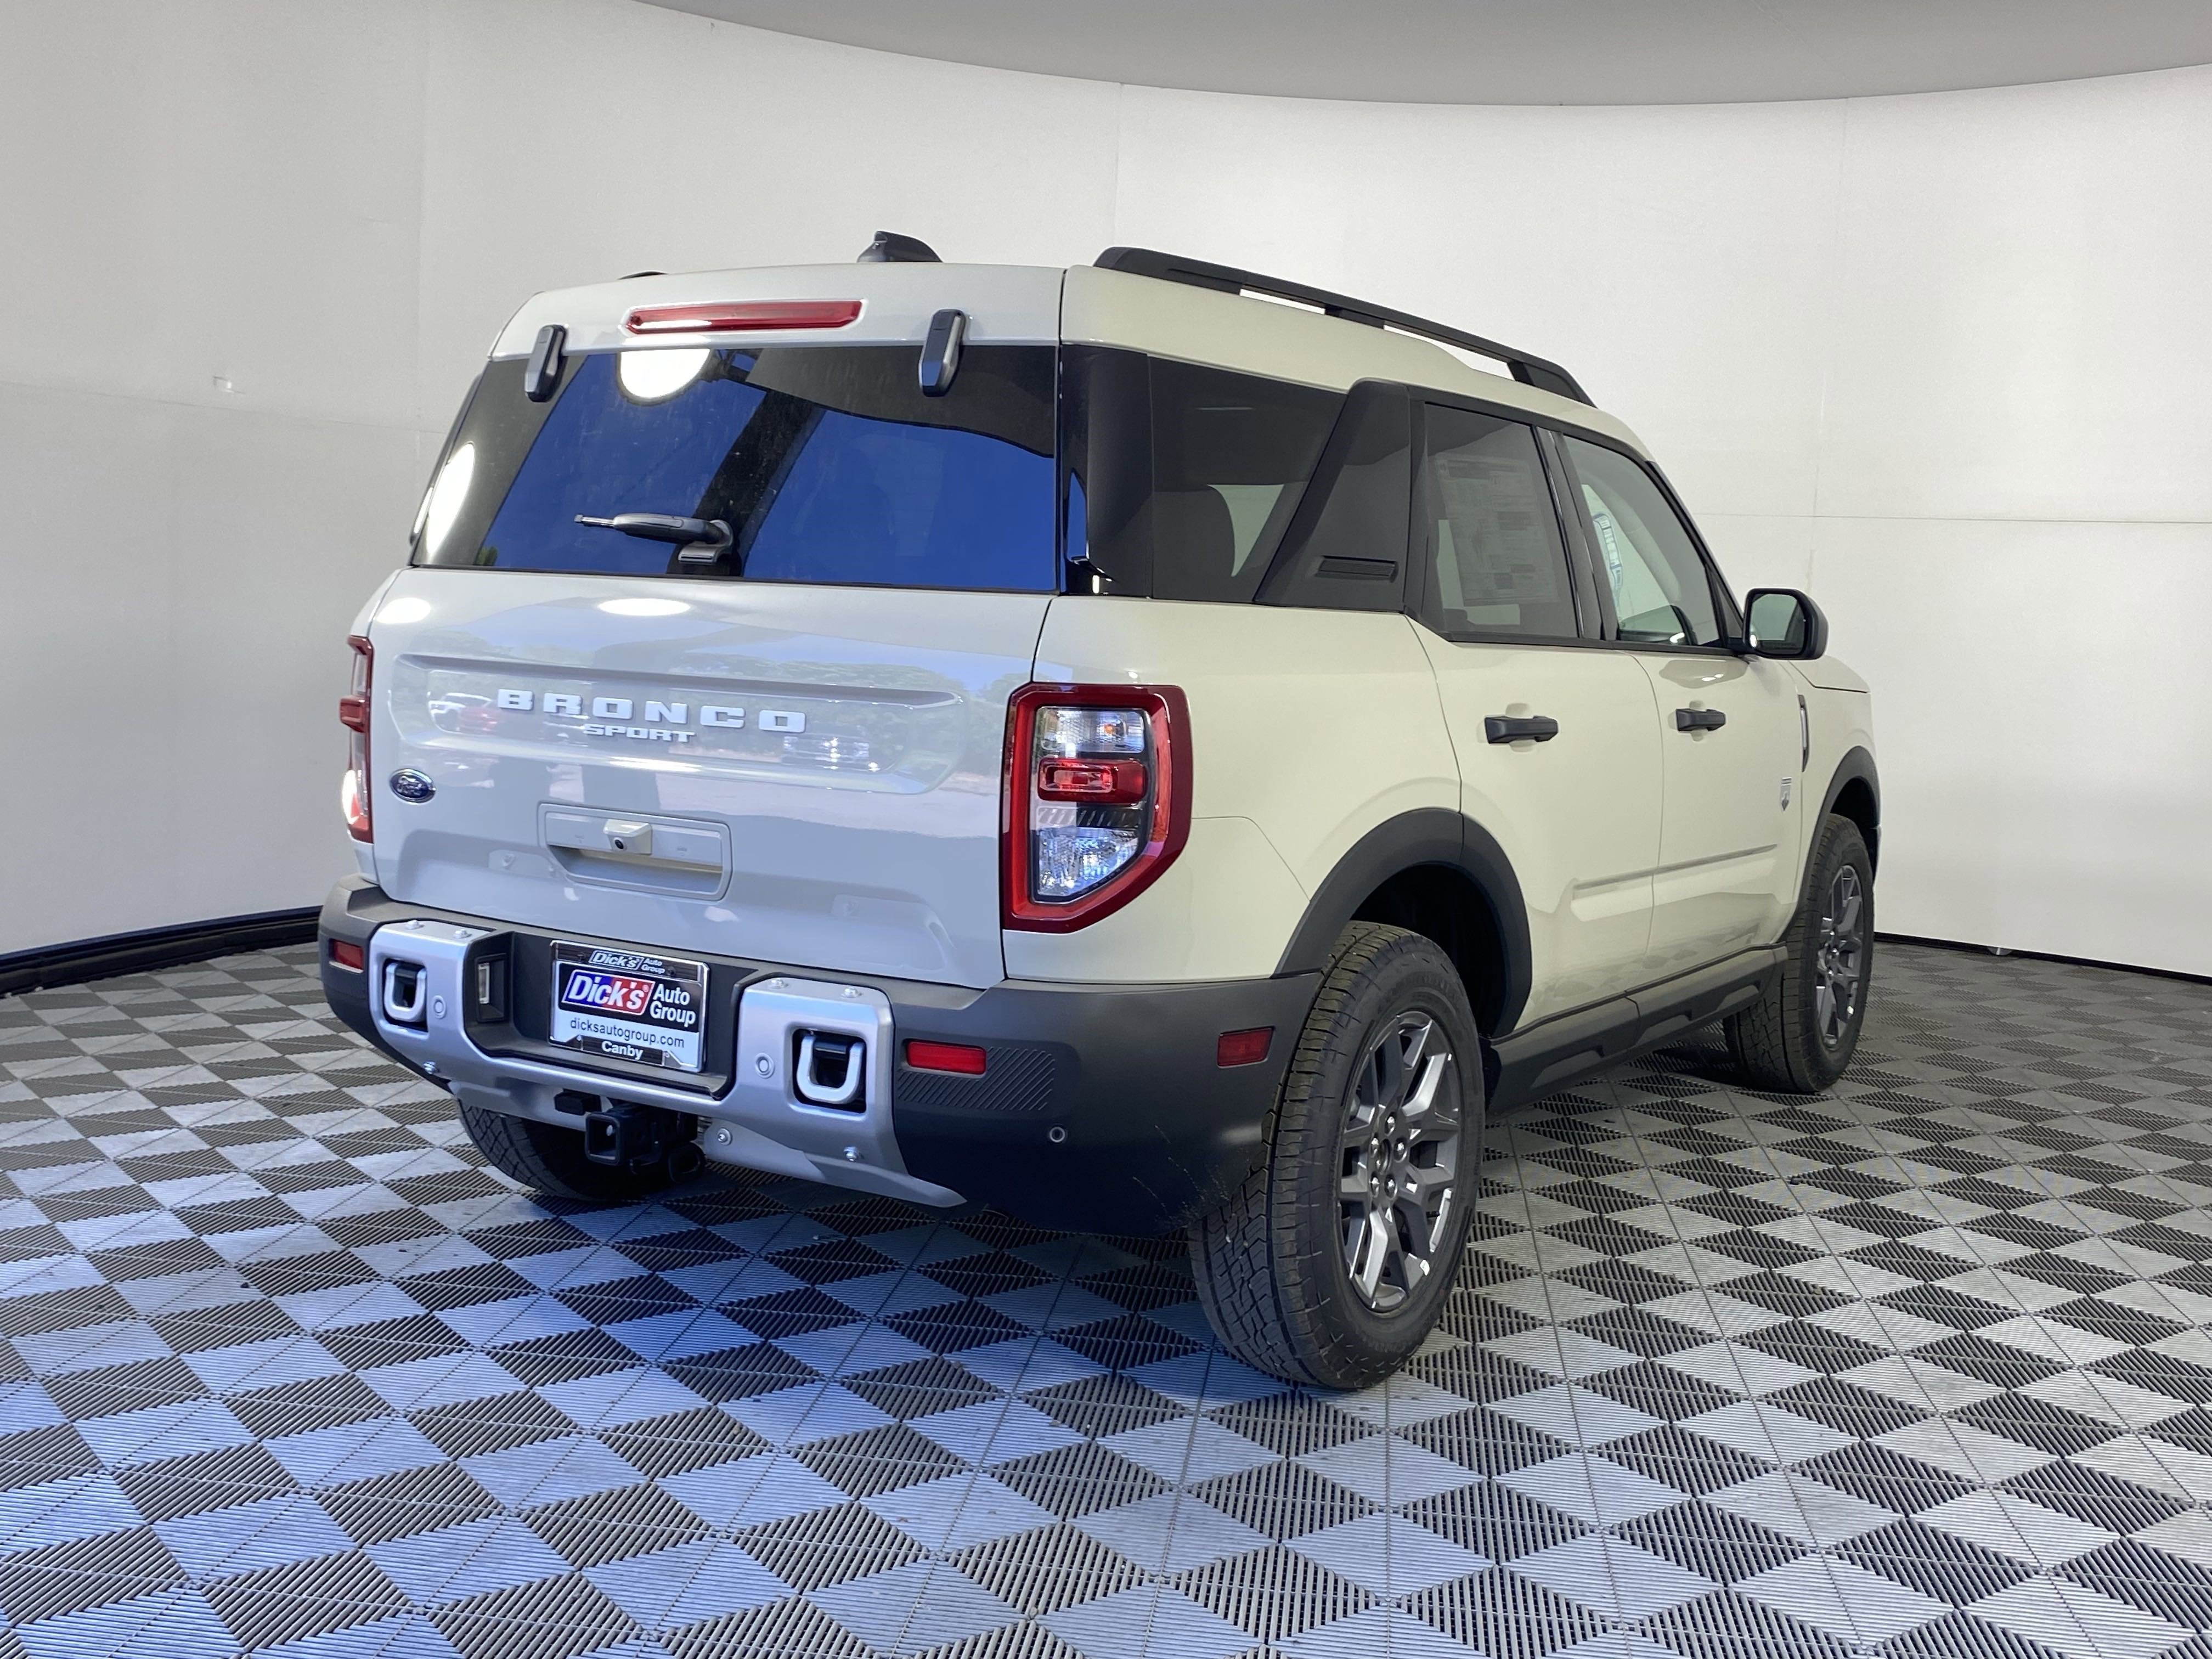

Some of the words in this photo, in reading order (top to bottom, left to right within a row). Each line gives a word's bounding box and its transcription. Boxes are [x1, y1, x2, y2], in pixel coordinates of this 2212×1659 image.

[498, 689, 806, 733] BRONCO
[583, 723, 696, 743] SPORT
[592, 952, 637, 968] Dick's
[641, 964, 665, 974] Group
[644, 958, 663, 966] Auto
[568, 975, 645, 1010] Dick's
[653, 984, 690, 1005] Auto
[650, 1001, 696, 1027] Group
[571, 1018, 685, 1048] dicksautogroup.com
[601, 1040, 644, 1060] Canby
